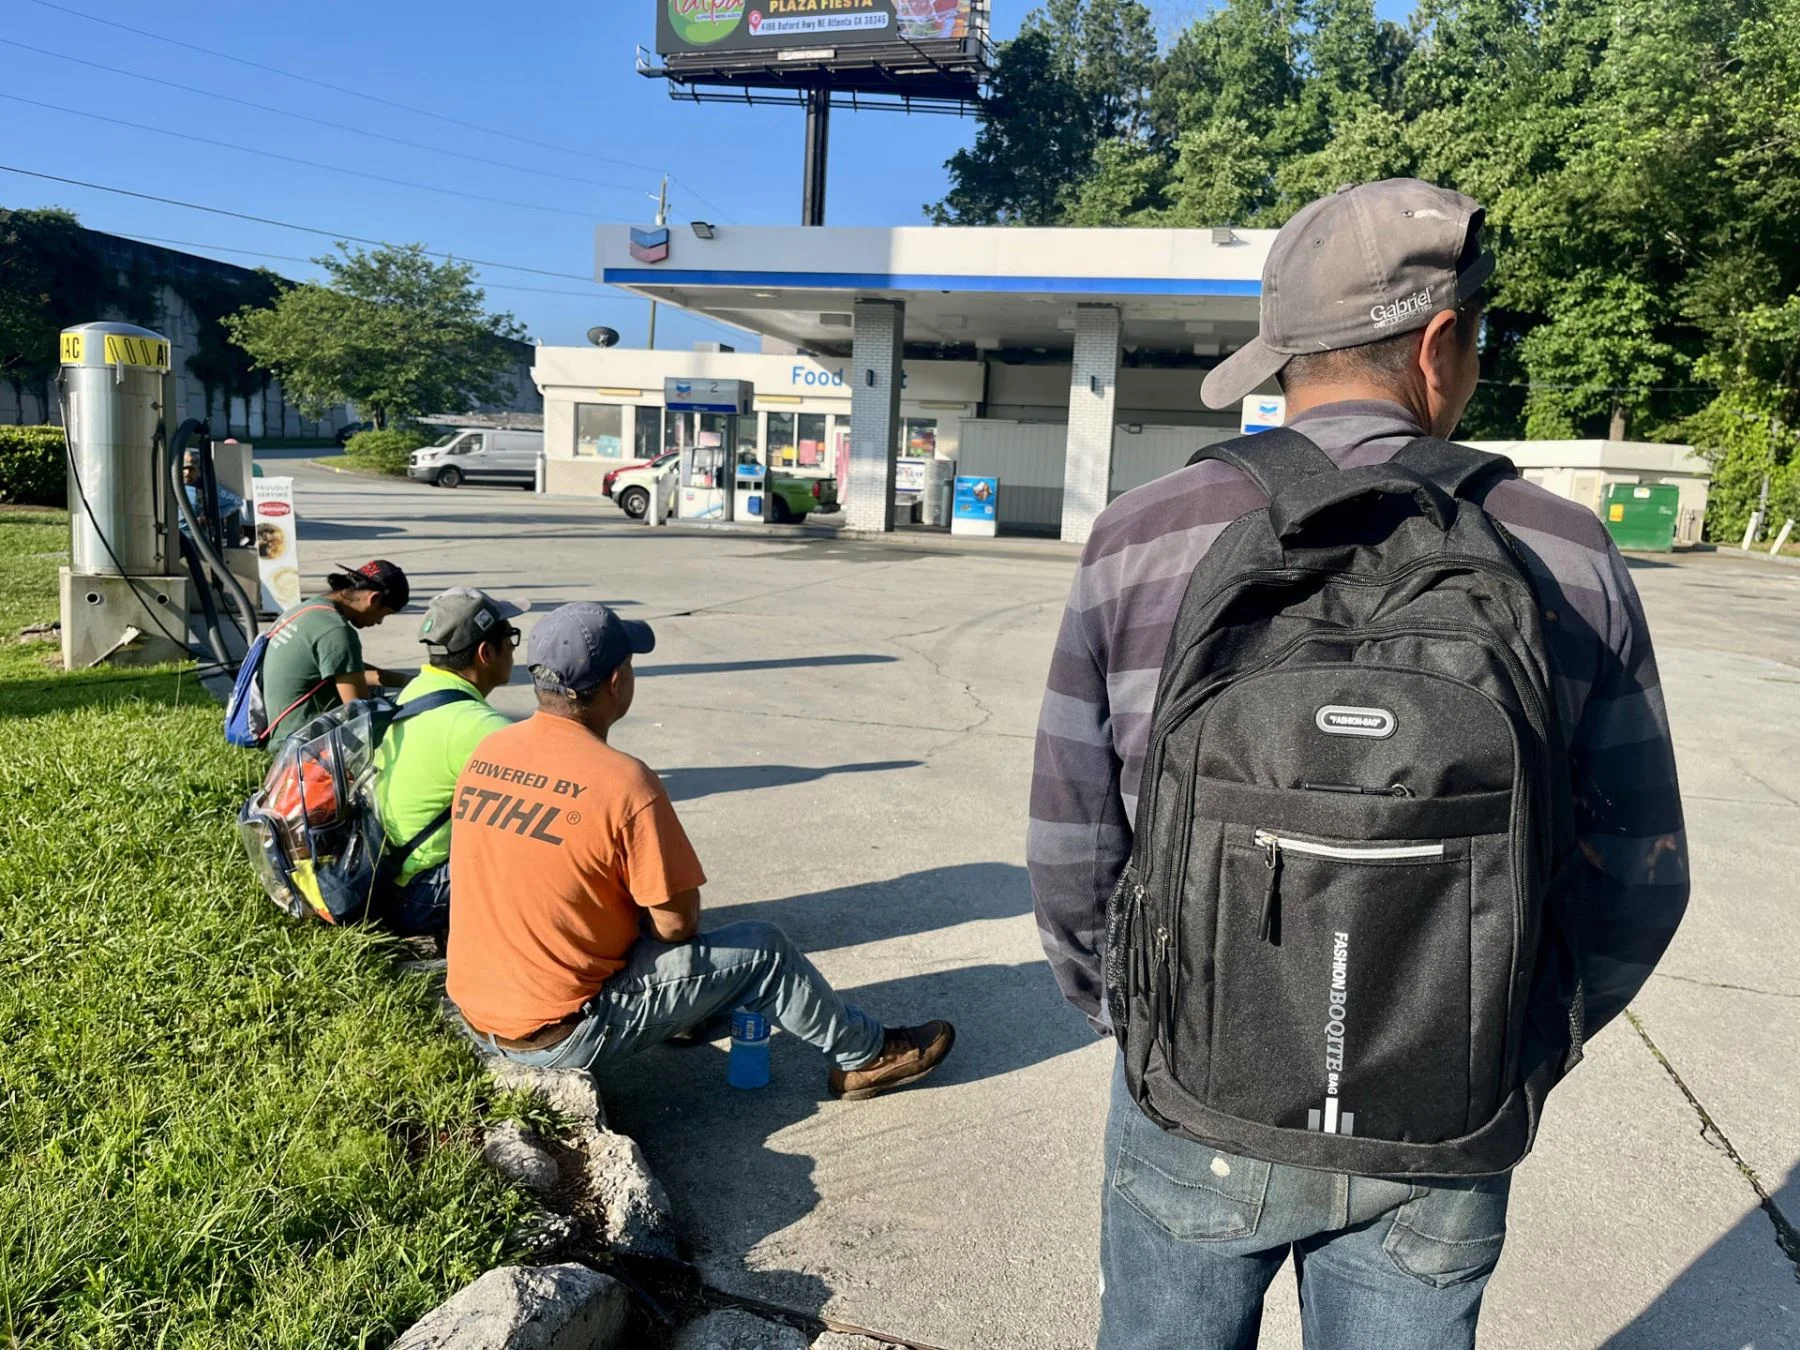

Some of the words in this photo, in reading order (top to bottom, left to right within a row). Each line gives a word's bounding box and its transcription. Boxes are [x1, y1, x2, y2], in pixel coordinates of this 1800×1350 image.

[769, 0, 817, 12] PLAZA
[1370, 286, 1432, 322] Gabriel
[710, 381, 719, 393] 2
[792, 366, 844, 386] Food
[469, 759, 549, 789] POWERED
[553, 779, 588, 799] BY
[1332, 931, 1349, 990] FASHION
[1327, 1073, 1339, 1095] BAG
